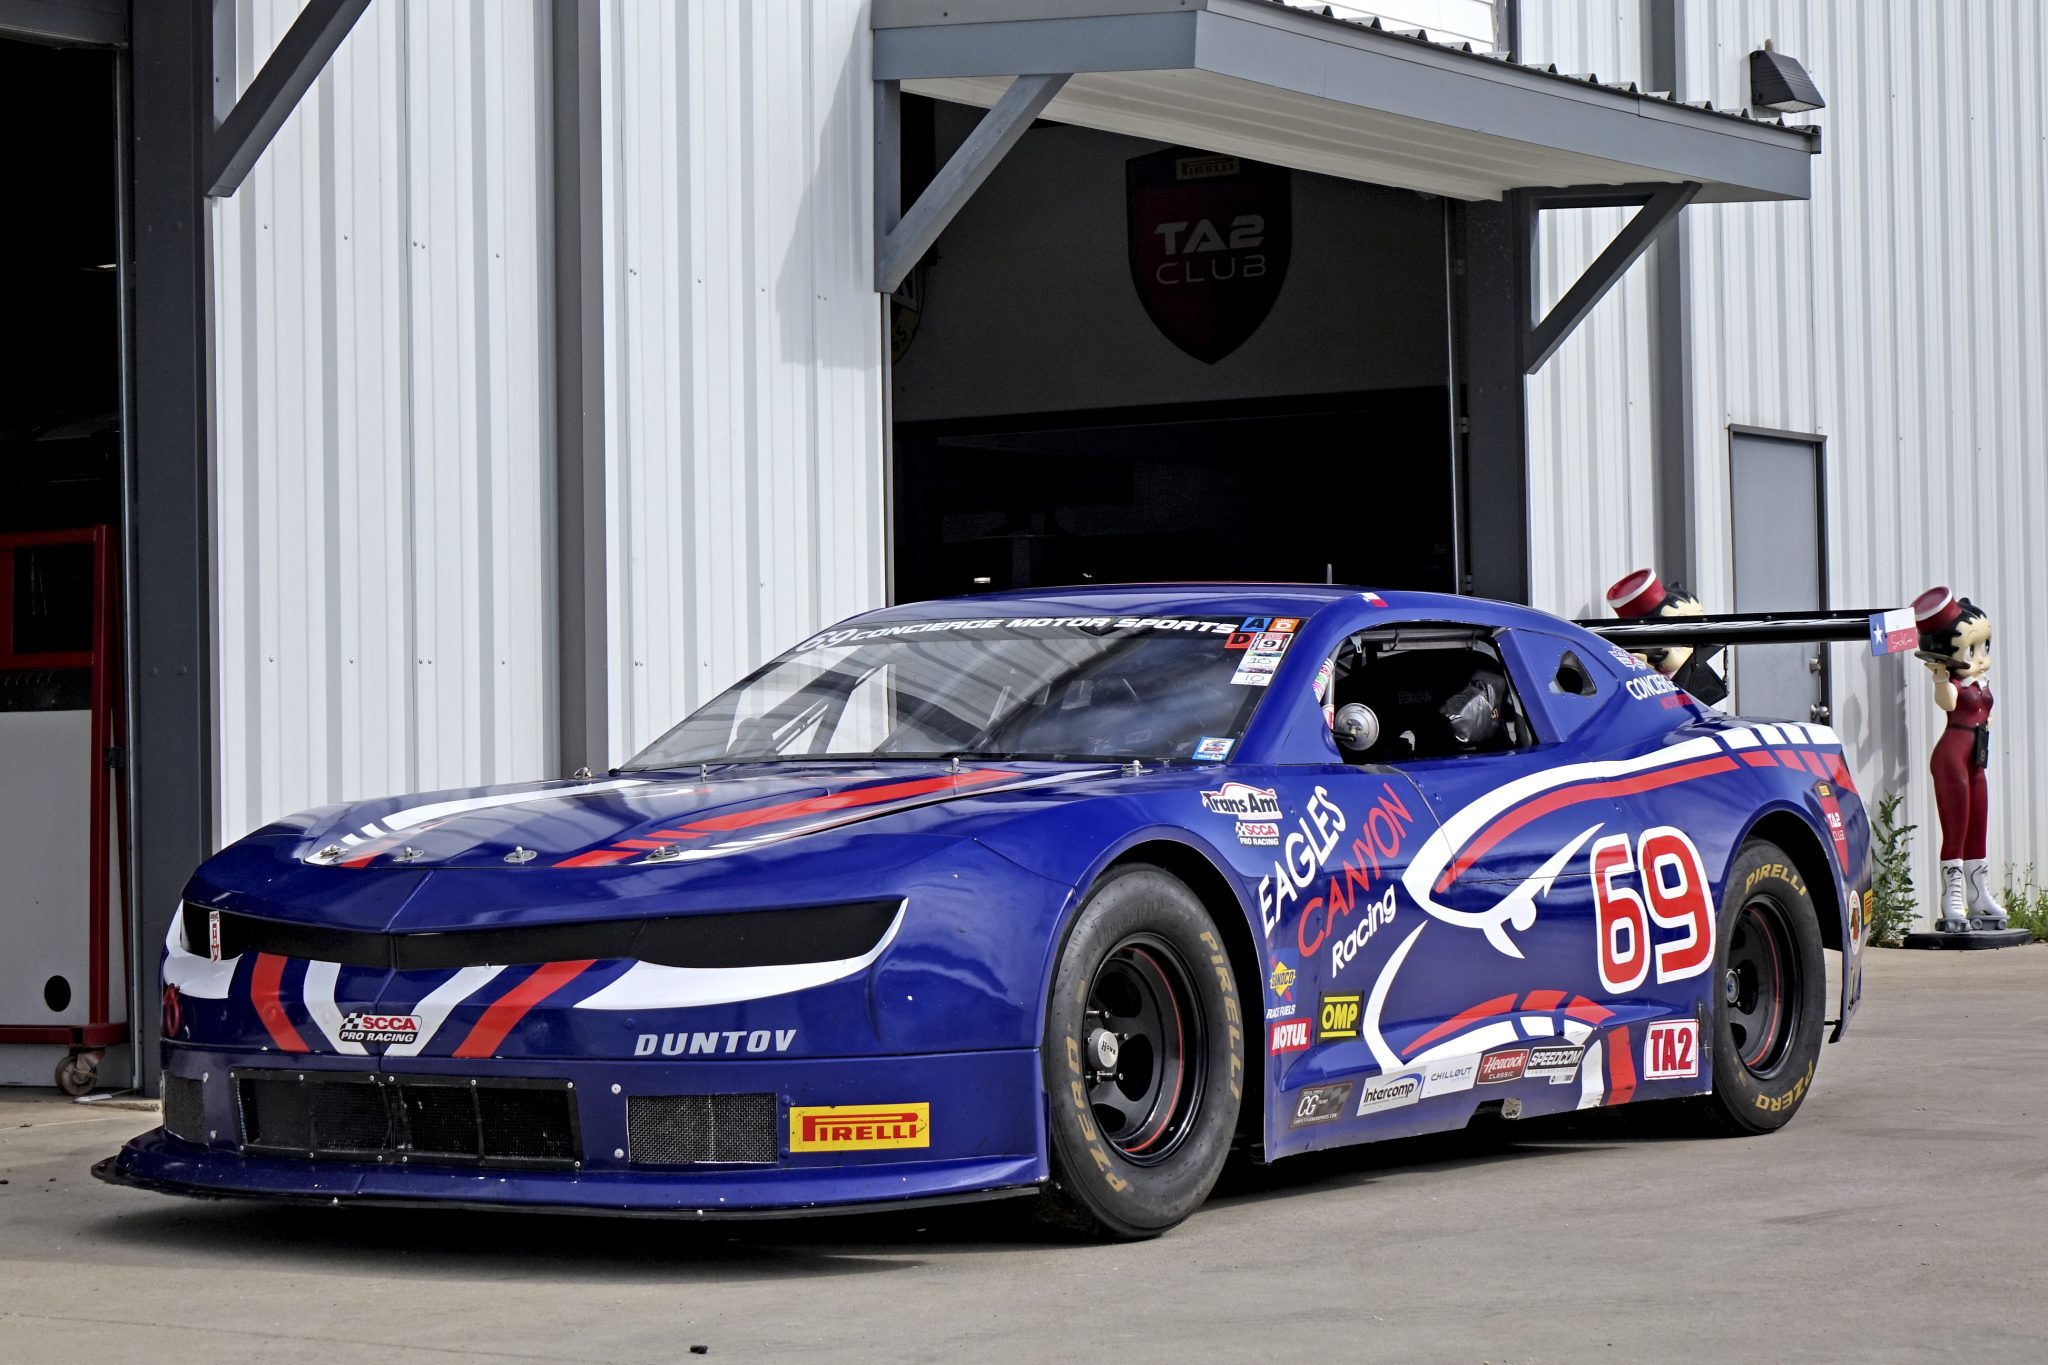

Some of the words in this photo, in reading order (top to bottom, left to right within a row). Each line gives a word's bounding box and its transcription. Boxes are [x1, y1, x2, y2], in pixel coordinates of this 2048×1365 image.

[1181, 156, 1234, 176] PIRELLI
[1153, 213, 1265, 256] TA2
[1155, 253, 1268, 285] CLUB
[850, 619, 1005, 641] CONCIERGE
[1005, 617, 1112, 628] MOTOR
[1113, 618, 1239, 634] SPORTS
[1230, 633, 1250, 645] D
[1202, 792, 1248, 813] Trans
[1247, 792, 1278, 813] Am
[1239, 837, 1253, 846] PRO
[1253, 837, 1279, 846] RACING
[1244, 824, 1277, 836] SCCA
[1258, 785, 1346, 939] EAGLES
[1297, 782, 1414, 957] CANYON
[1745, 863, 1807, 897] PIRELLI
[1590, 825, 1716, 994] 69
[1332, 884, 1397, 979] Racing
[1271, 971, 1295, 988] SUNOCO
[362, 1016, 417, 1031] SCCA
[1199, 930, 1243, 1101] PIRELLI
[1321, 1003, 1358, 1030] OMP
[341, 1031, 364, 1040] PRO
[366, 1032, 415, 1043] RACING
[633, 1029, 797, 1056] DUNTOV
[1272, 1022, 1308, 1051] MOTUL
[1529, 1049, 1581, 1067] SPEEDCOM
[1650, 1027, 1694, 1072] TA2
[1484, 1054, 1526, 1075] Heacock
[1363, 1082, 1415, 1103] Intercomp
[1297, 1094, 1319, 1117] CG
[802, 1112, 919, 1142] PIRELLI
